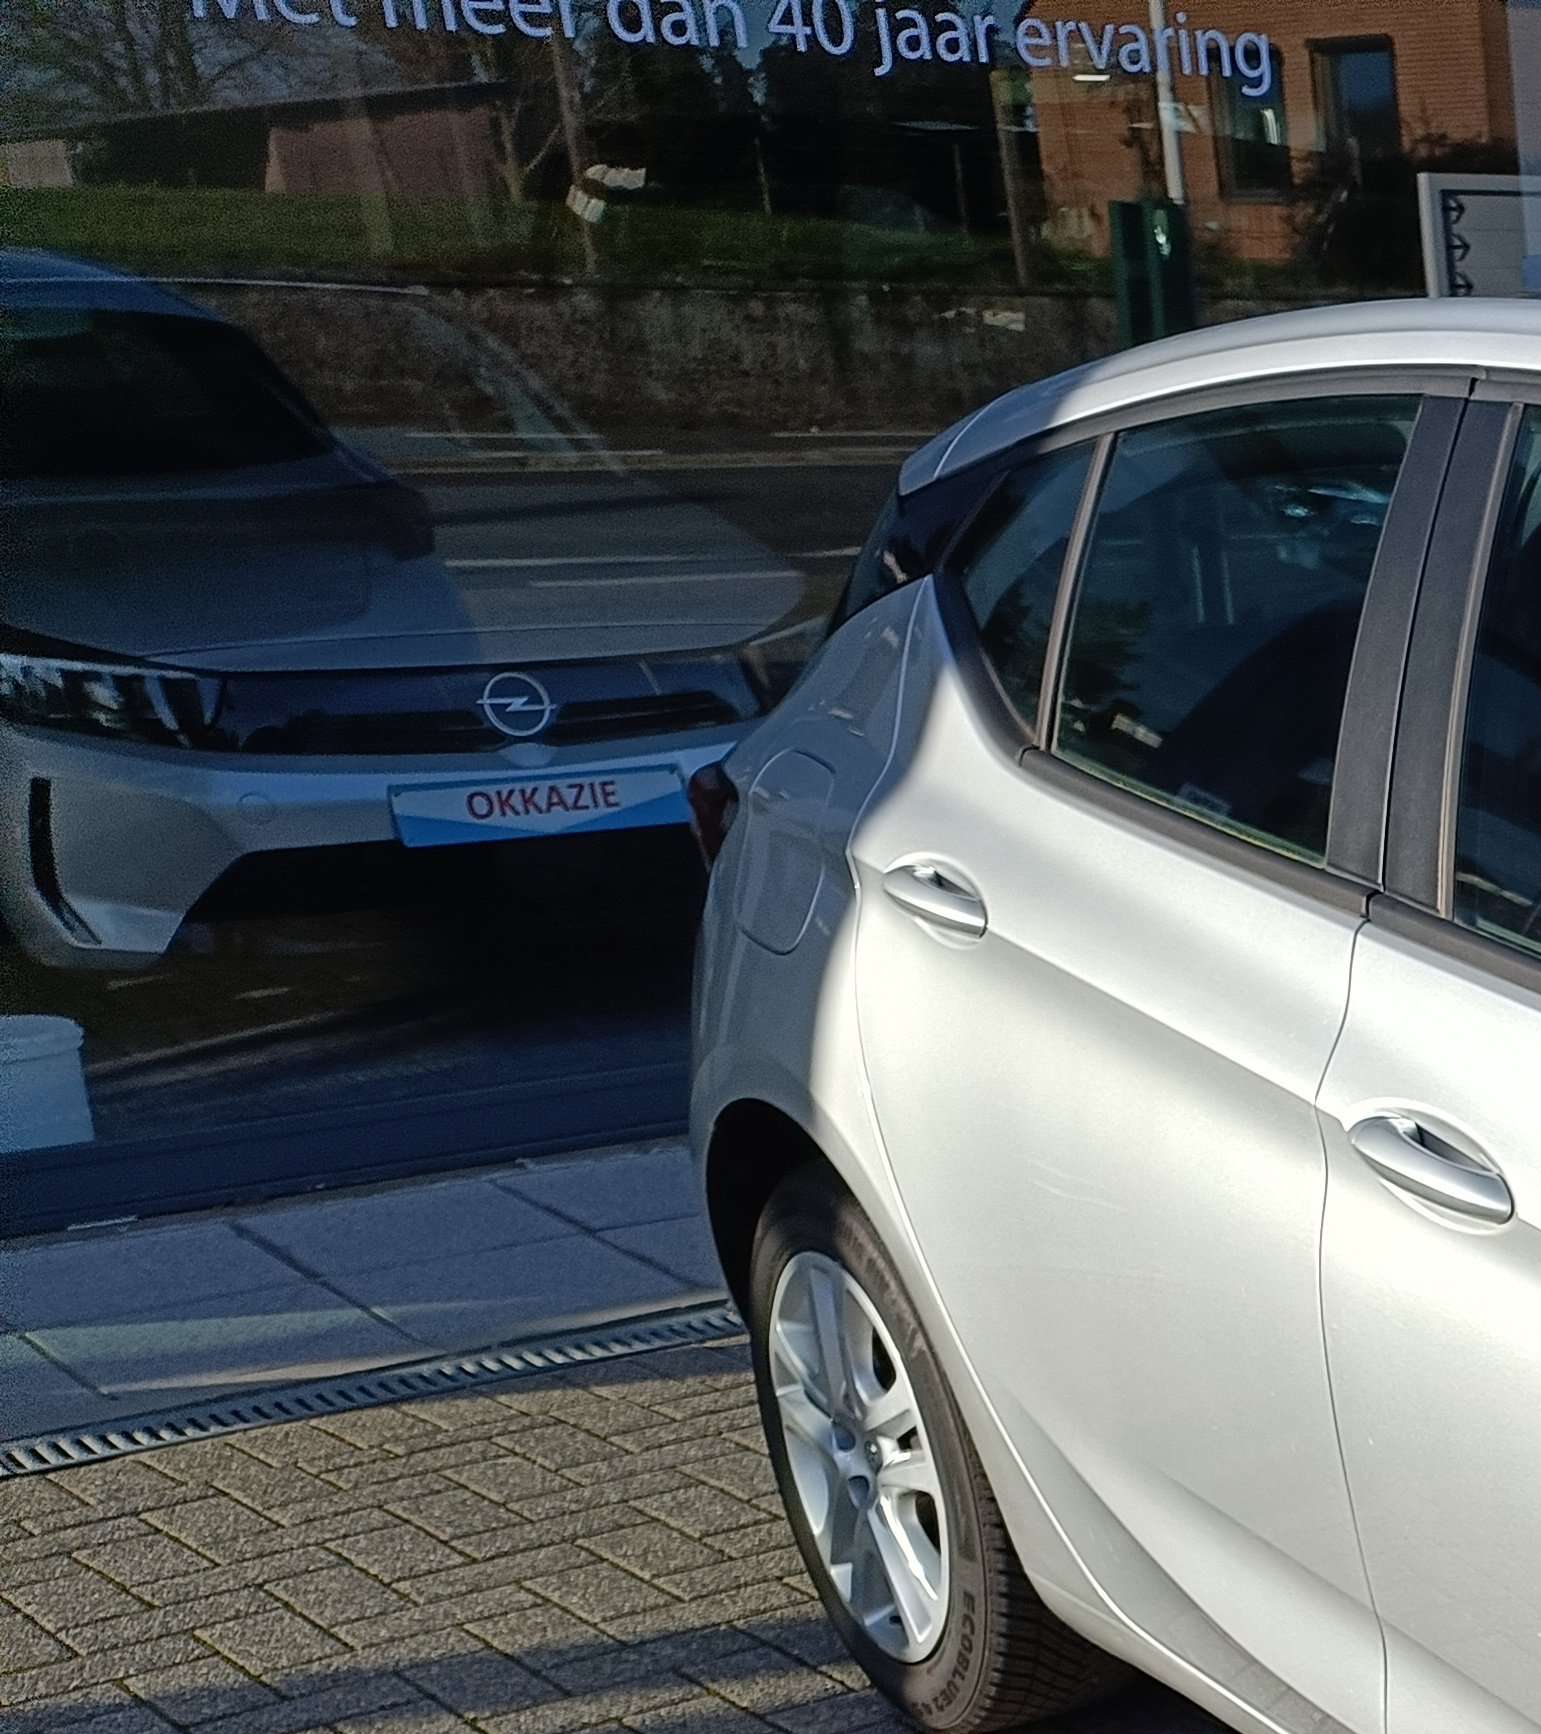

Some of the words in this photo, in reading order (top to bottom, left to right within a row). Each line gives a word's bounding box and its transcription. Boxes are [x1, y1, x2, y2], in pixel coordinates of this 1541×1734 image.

[382, 0, 578, 38] meer
[606, 0, 748, 48] dan
[768, 0, 855, 55] 40
[873, 0, 995, 76] jaar
[1016, 12, 1273, 96] ervaring
[466, 780, 621, 820] OKKAZIE
